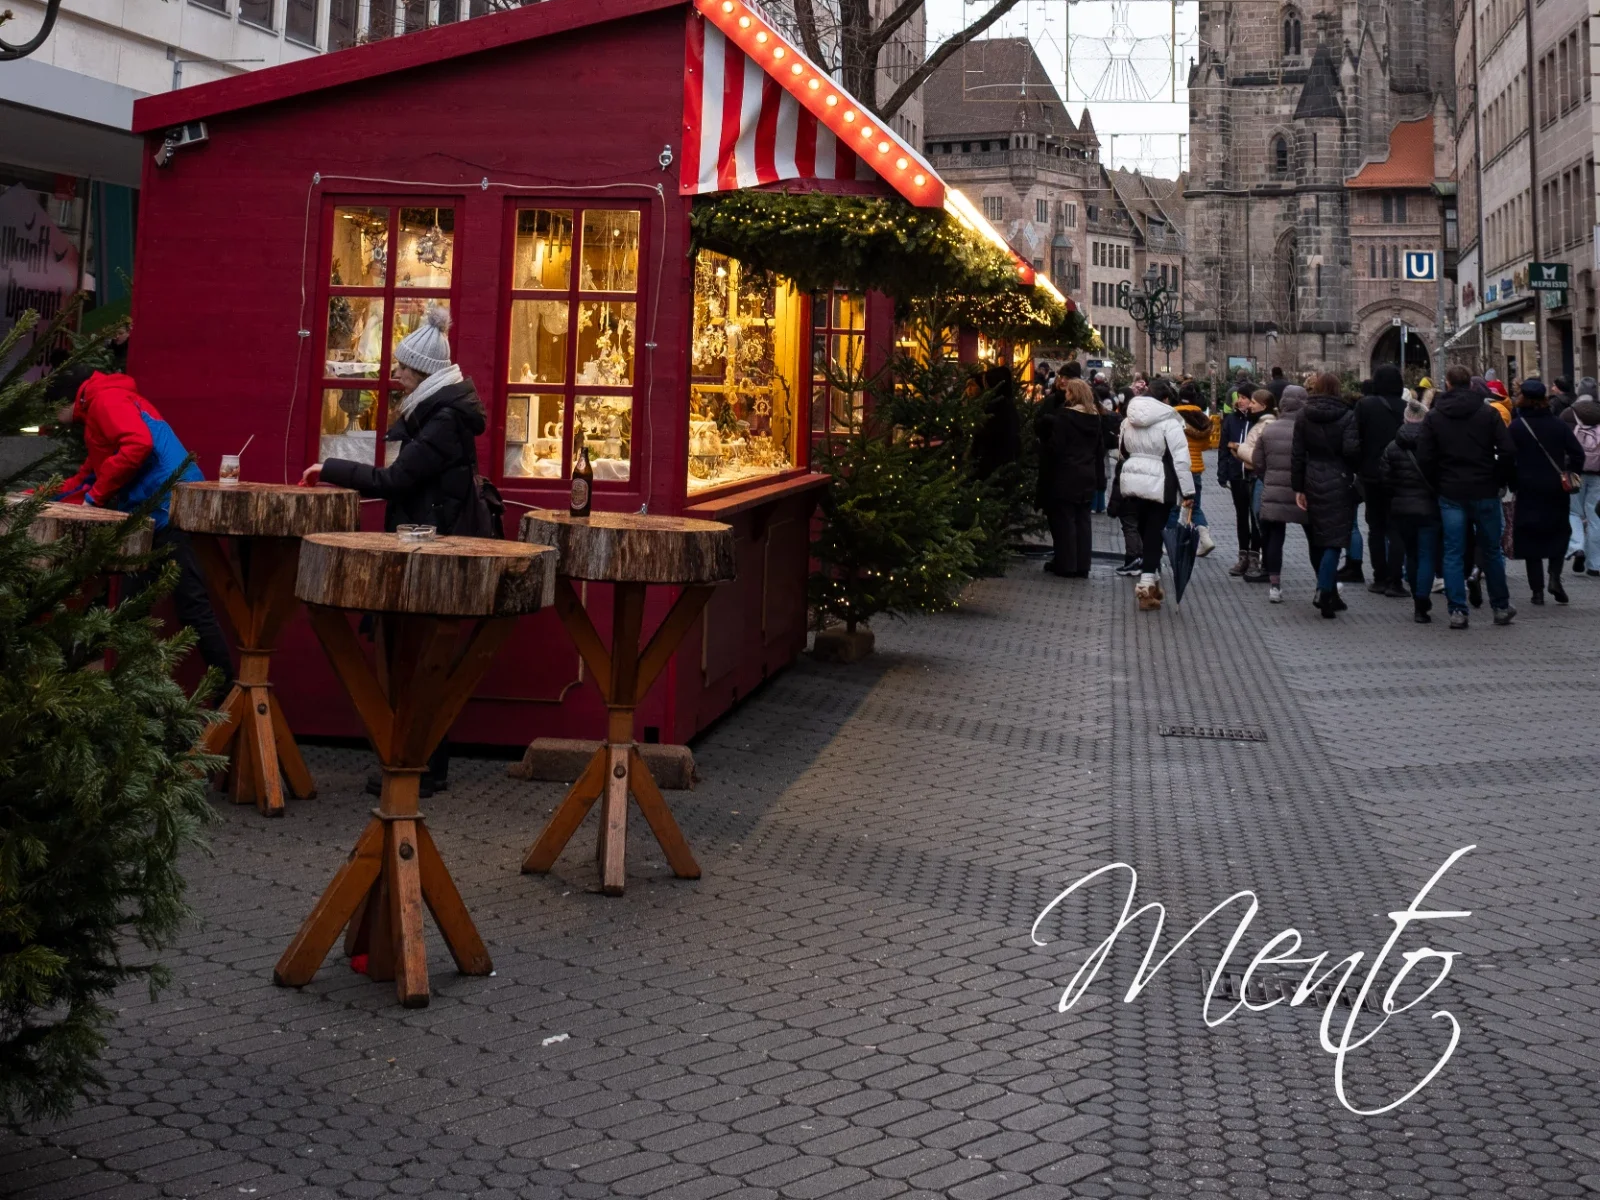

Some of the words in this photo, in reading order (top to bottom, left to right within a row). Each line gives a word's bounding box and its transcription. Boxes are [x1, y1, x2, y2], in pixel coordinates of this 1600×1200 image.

[0, 225, 50, 274] ukunft
[1411, 255, 1429, 277] U
[1541, 266, 1557, 280] M
